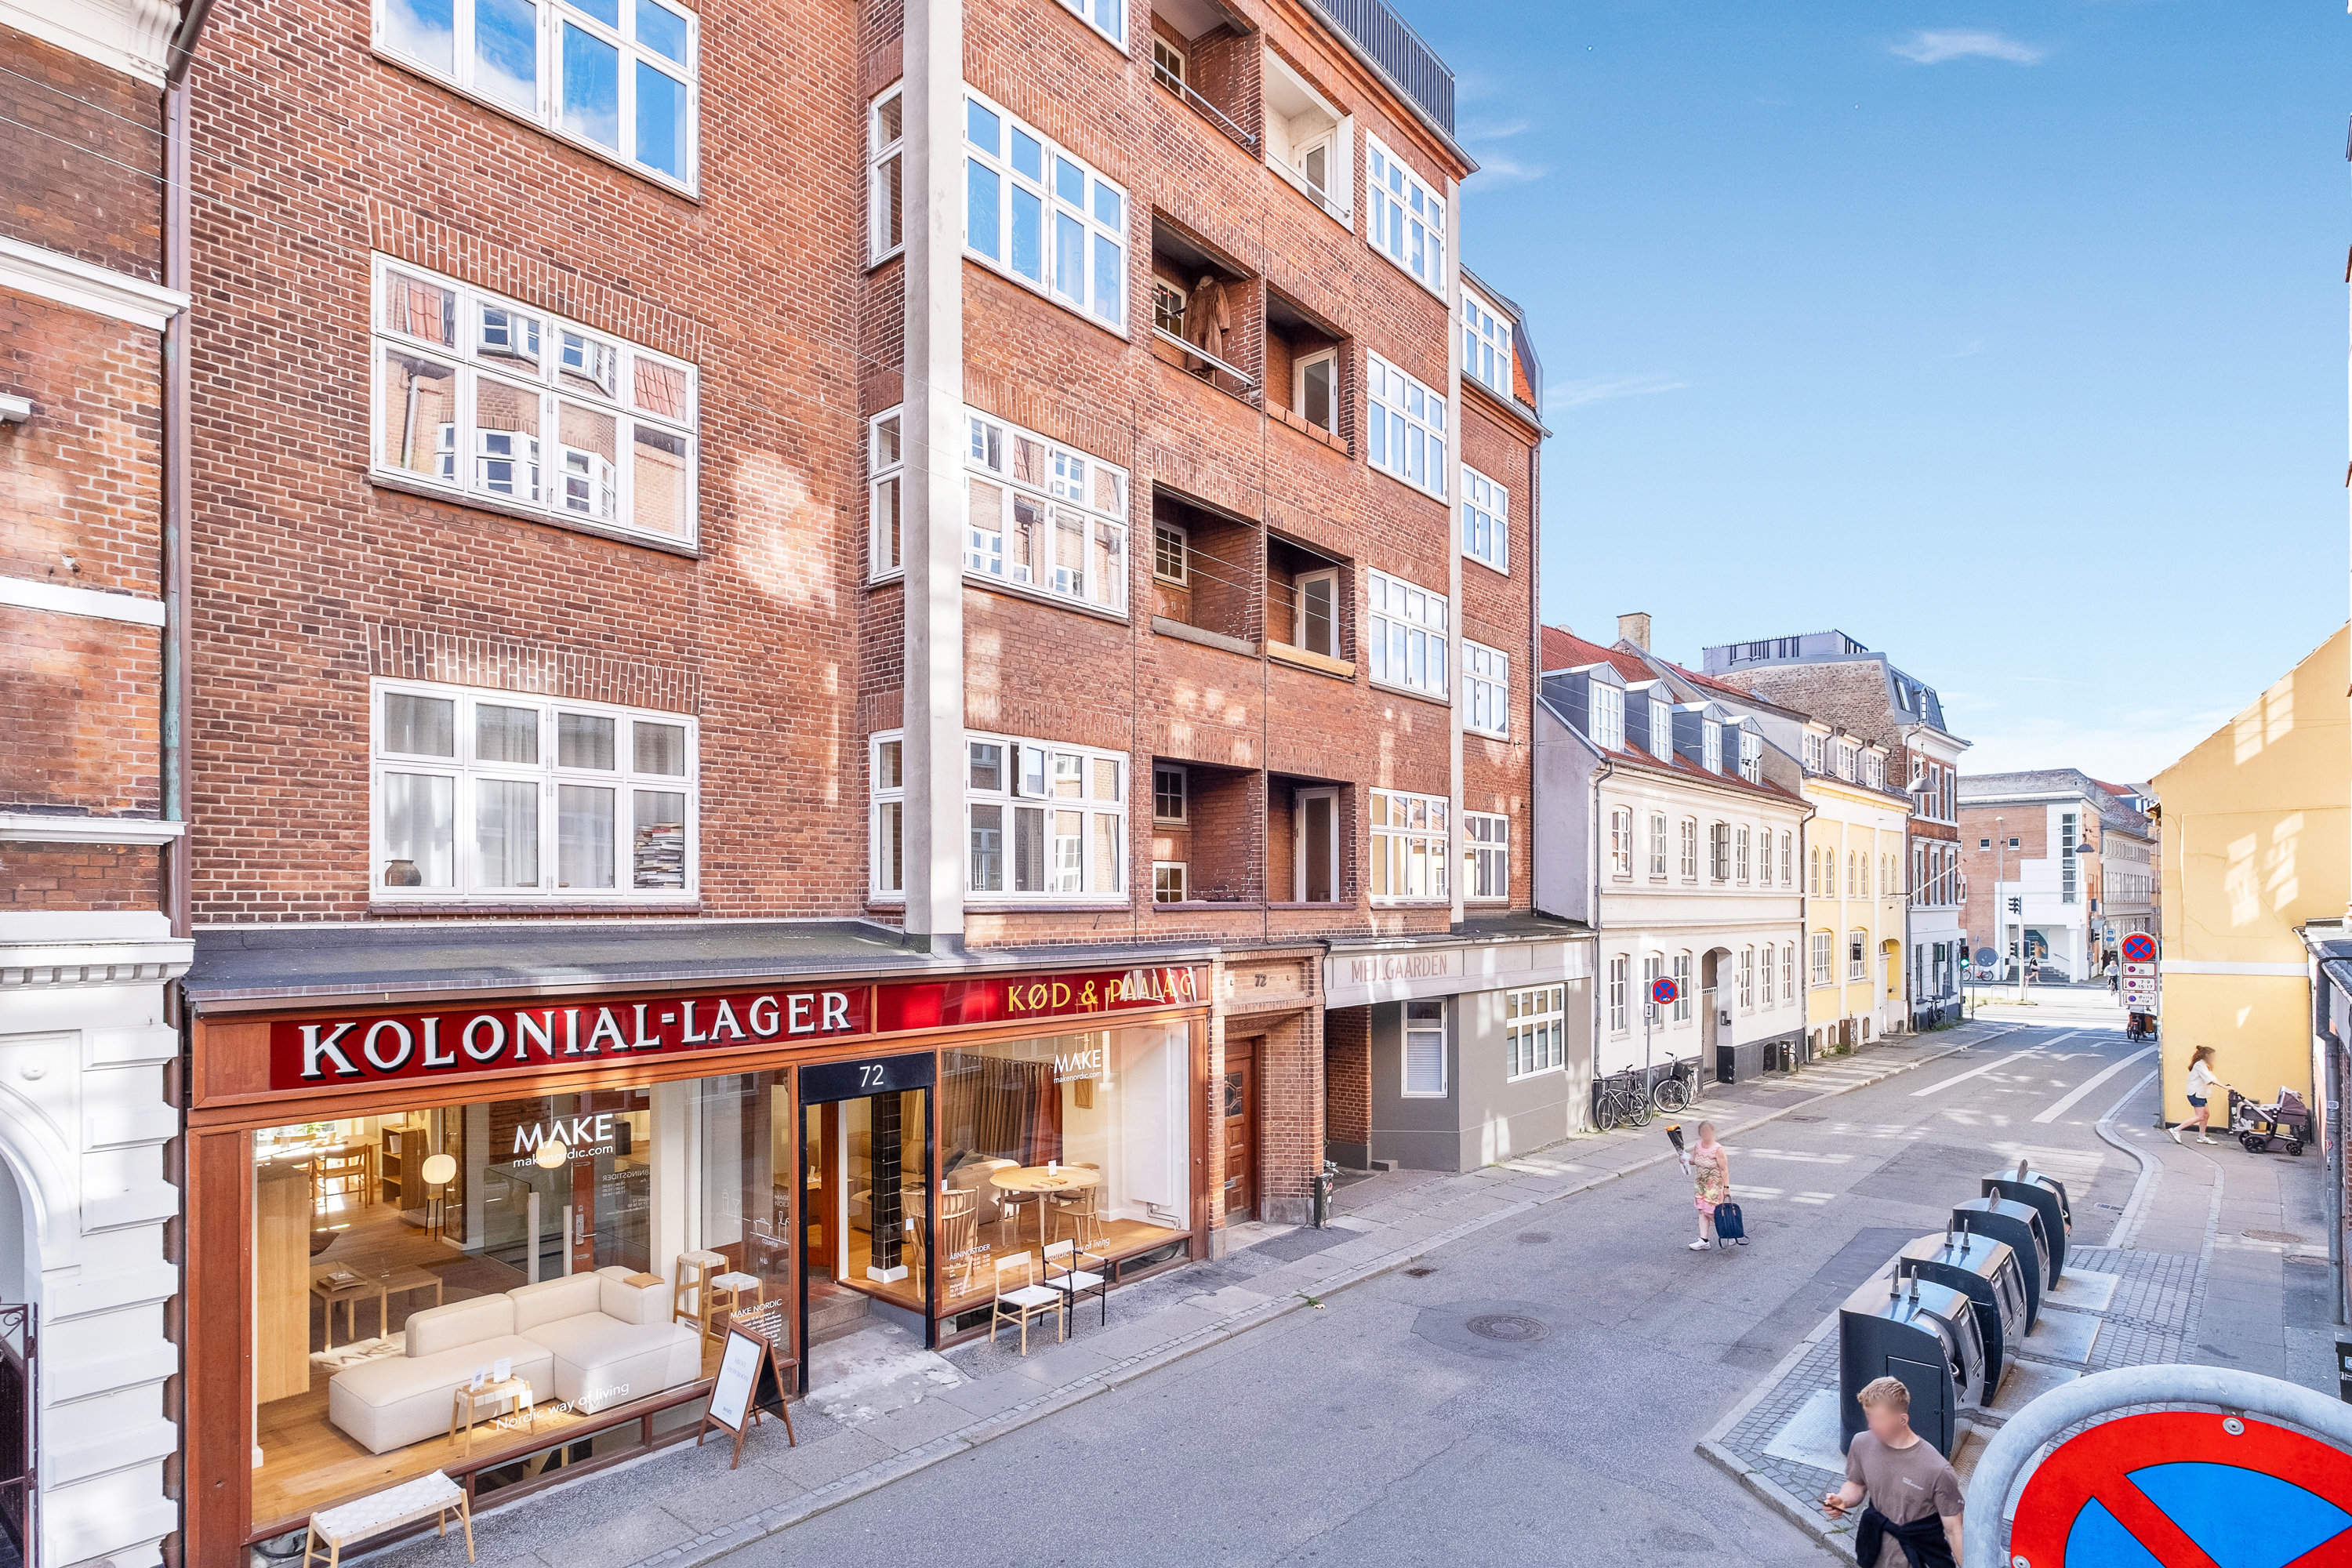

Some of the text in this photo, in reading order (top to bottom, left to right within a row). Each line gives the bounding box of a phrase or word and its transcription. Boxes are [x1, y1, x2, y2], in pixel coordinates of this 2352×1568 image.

[1351, 954, 1447, 983] MEJLGAARDEN
[1254, 974, 1267, 987] 72
[1008, 982, 1071, 1012] KØD
[1080, 980, 1098, 1005] &
[1053, 1049, 1102, 1074] MAKE
[859, 1064, 884, 1087] 72
[1053, 1071, 1102, 1084] makenordic.com
[513, 1113, 613, 1154] MAKE
[513, 1145, 613, 1168] makenordic.com
[761, 1238, 779, 1248] COUNTER
[949, 1243, 991, 1261] ÅBNINGSTIDER
[1084, 1240, 1093, 1250] of
[1093, 1237, 1111, 1248] living
[730, 1307, 752, 1319] MAKE
[753, 1298, 782, 1312] NORDIC
[496, 1382, 630, 1432] Nordic way of living
